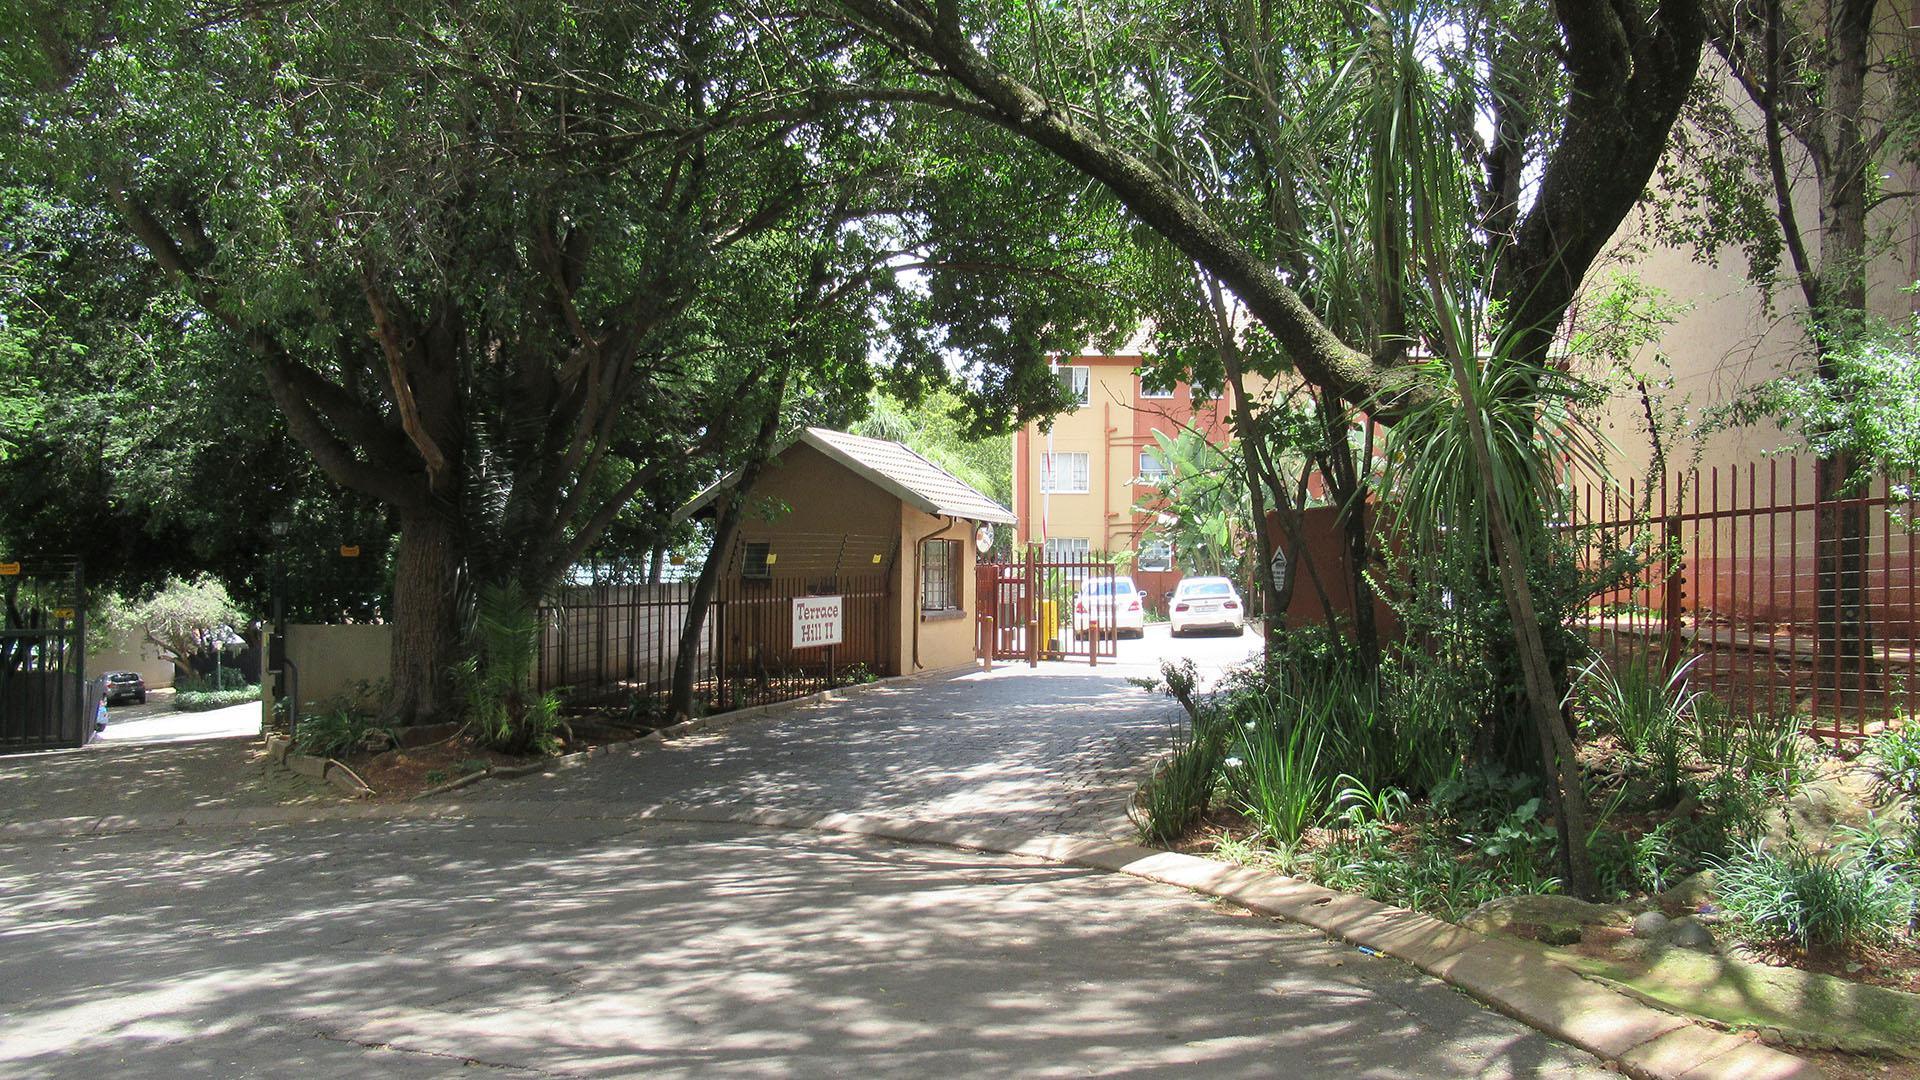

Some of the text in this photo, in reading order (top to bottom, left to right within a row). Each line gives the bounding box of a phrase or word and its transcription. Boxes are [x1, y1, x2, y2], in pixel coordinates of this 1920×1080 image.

[796, 603, 839, 620] Terrace
[801, 622, 834, 642] Hill II
